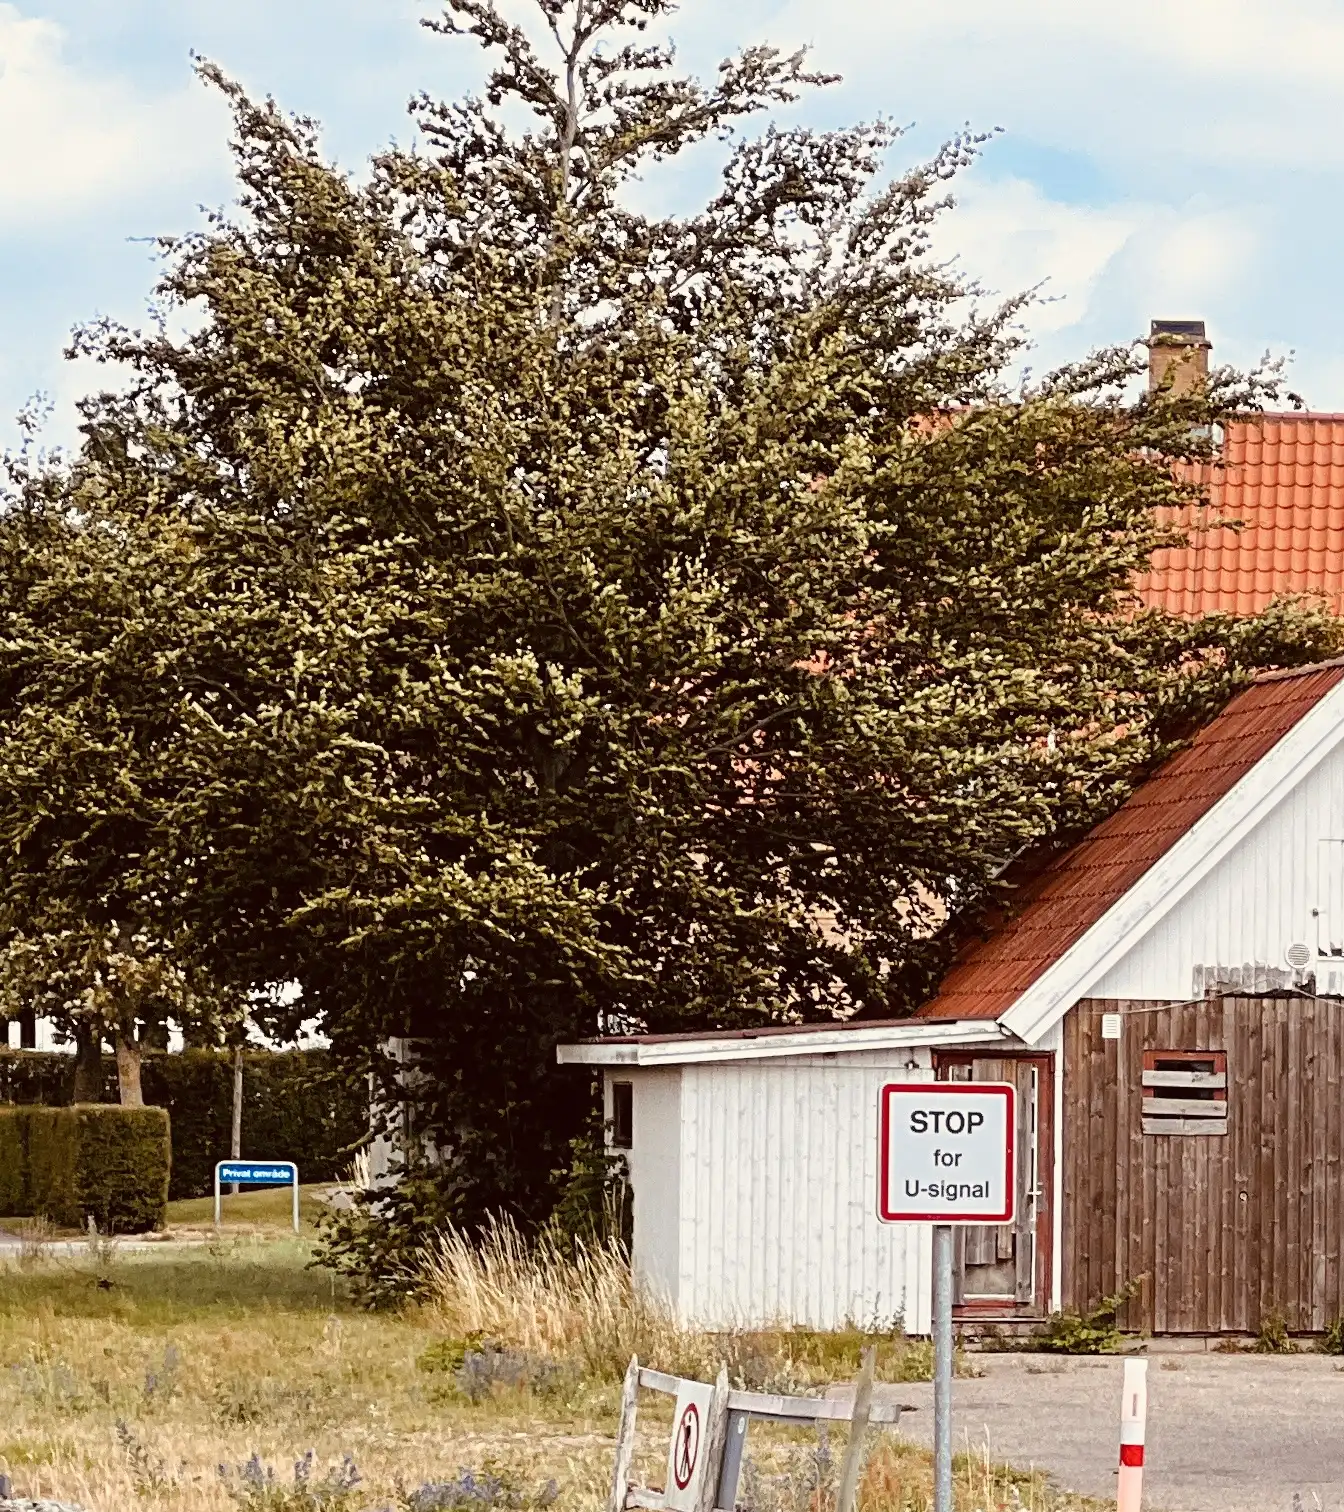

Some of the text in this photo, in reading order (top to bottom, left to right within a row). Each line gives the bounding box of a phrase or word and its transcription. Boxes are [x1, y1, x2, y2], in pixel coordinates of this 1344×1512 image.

[910, 1110, 984, 1134] STOP
[933, 1149, 963, 1167] for
[222, 1168, 251, 1179] Privat
[905, 1179, 989, 1201] U-signal
